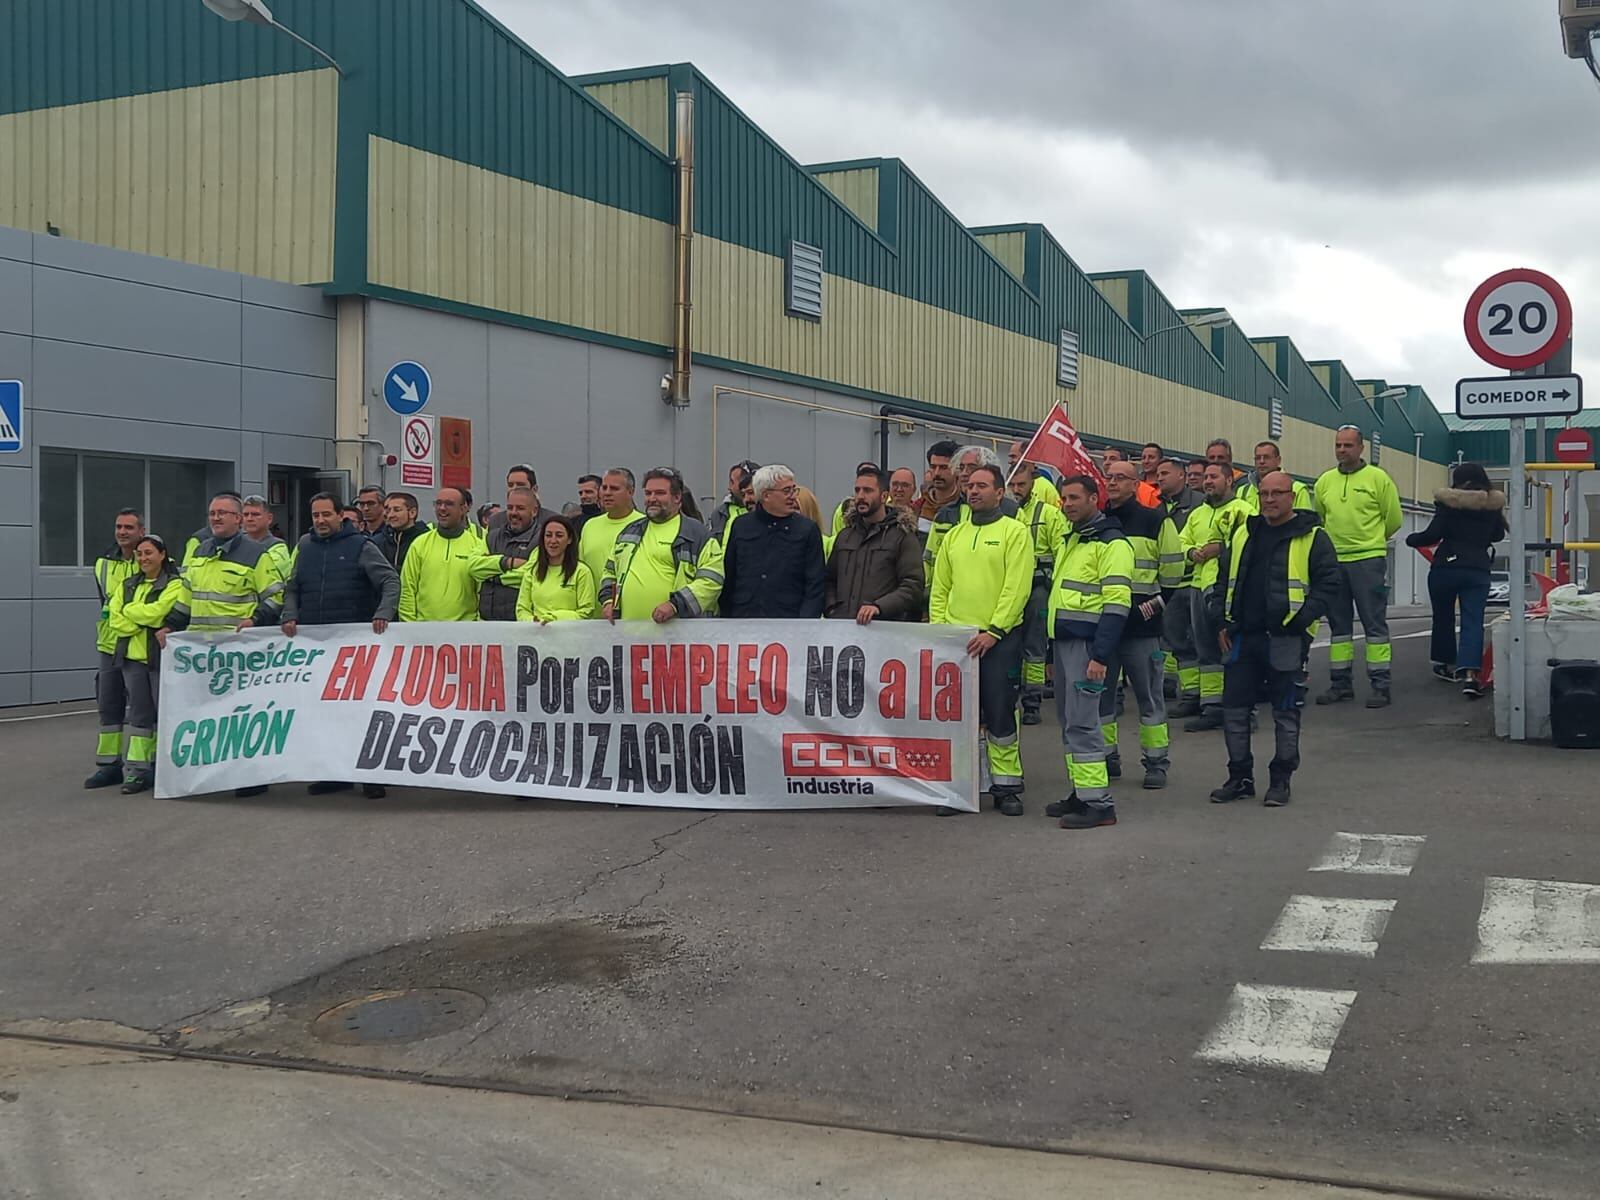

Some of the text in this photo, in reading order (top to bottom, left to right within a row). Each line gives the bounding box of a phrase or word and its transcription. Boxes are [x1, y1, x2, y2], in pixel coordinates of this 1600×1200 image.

[1487, 301, 1548, 336] 20
[1466, 389, 1547, 405] COMEDOR
[173, 641, 325, 674] Schneider
[237, 668, 312, 691] Electric
[321, 642, 963, 722] EN LUCHA Por el EMPLEO NO a la
[170, 700, 295, 768] GRIÑÓN
[355, 710, 747, 796] DESLOCALIZACIÓN
[791, 742, 897, 769] CCOO
[786, 777, 874, 795] industria
